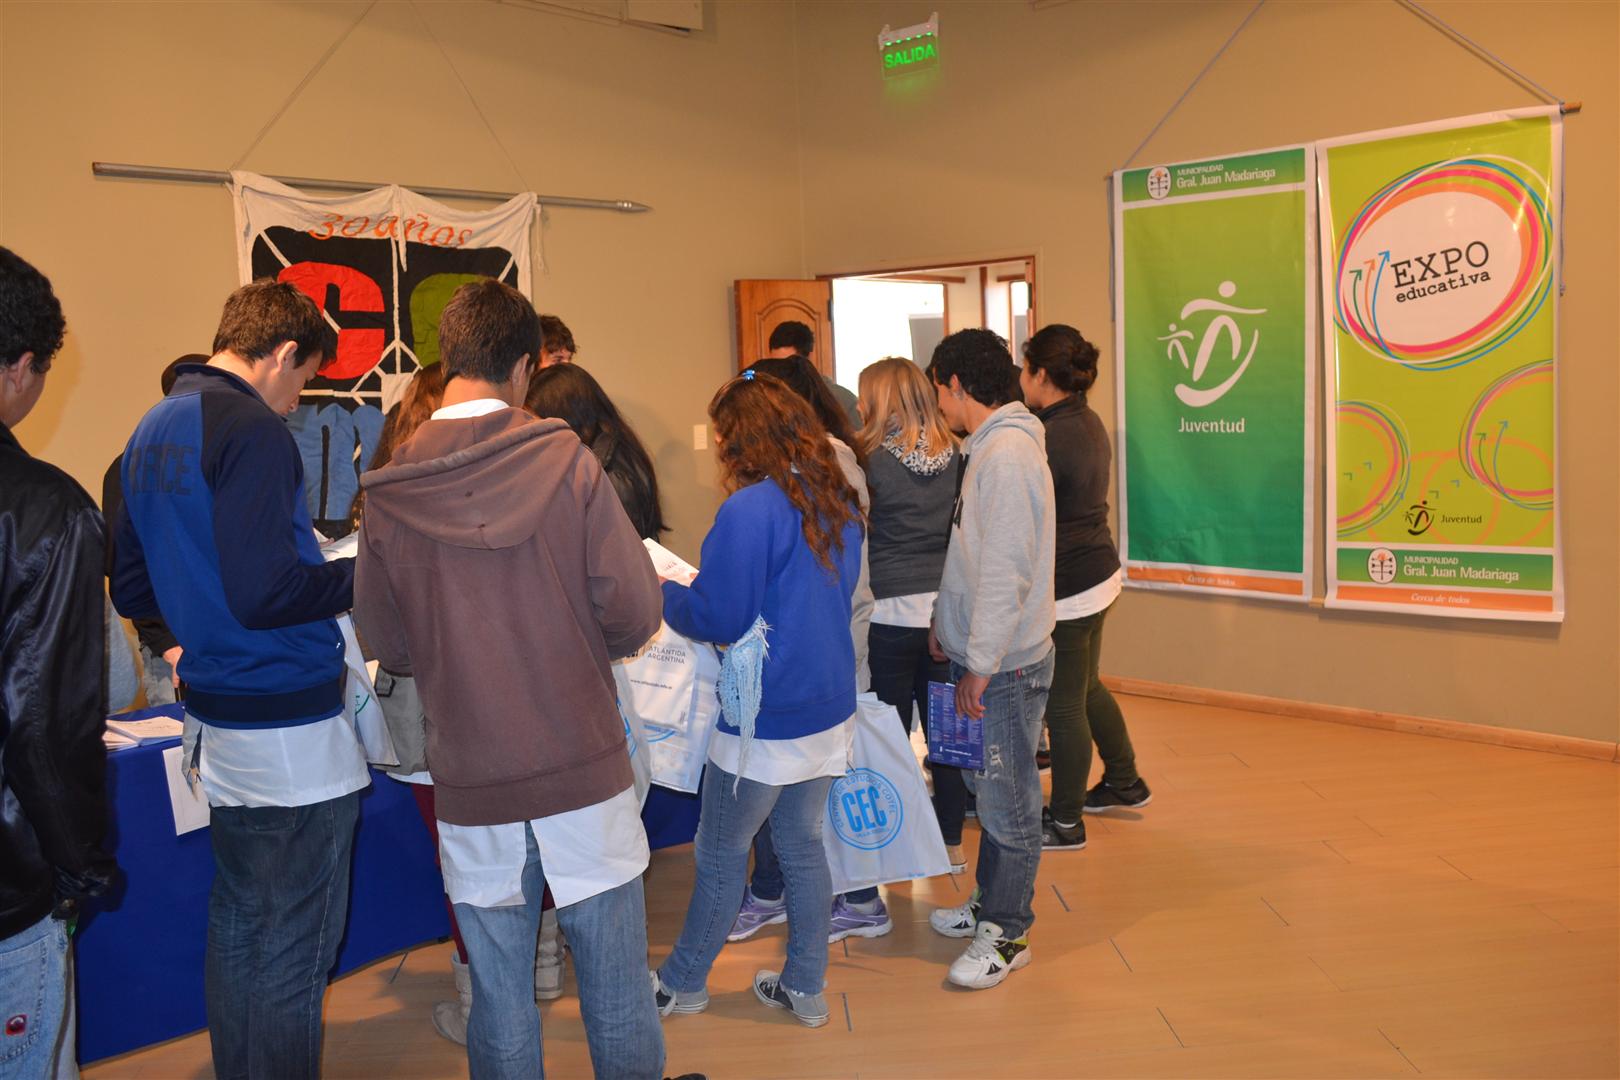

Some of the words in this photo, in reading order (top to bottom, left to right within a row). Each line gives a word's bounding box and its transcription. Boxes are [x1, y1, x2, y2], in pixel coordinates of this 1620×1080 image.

[884, 43, 936, 68] SALIDA
[1176, 176, 1198, 189] Gral.
[1199, 174, 1222, 186] Juan
[1224, 167, 1276, 183] Madariaga
[1177, 164, 1224, 176] MUNICIPALIDAD
[1390, 240, 1490, 288] EXPO
[1396, 270, 1491, 303] educativa
[1178, 416, 1246, 433] Juventud
[1441, 514, 1483, 524] Juventud
[1404, 555, 1459, 565] MUNICIPALIDAD
[1403, 564, 1428, 577] Gral.
[1431, 565, 1456, 578] Juan
[1460, 566, 1519, 584] Madariaga
[1411, 592, 1434, 602] Cerca
[1435, 593, 1446, 603] de
[1448, 594, 1471, 604] todos
[647, 653, 685, 664] ARGENTINA
[841, 785, 887, 833] CEC
